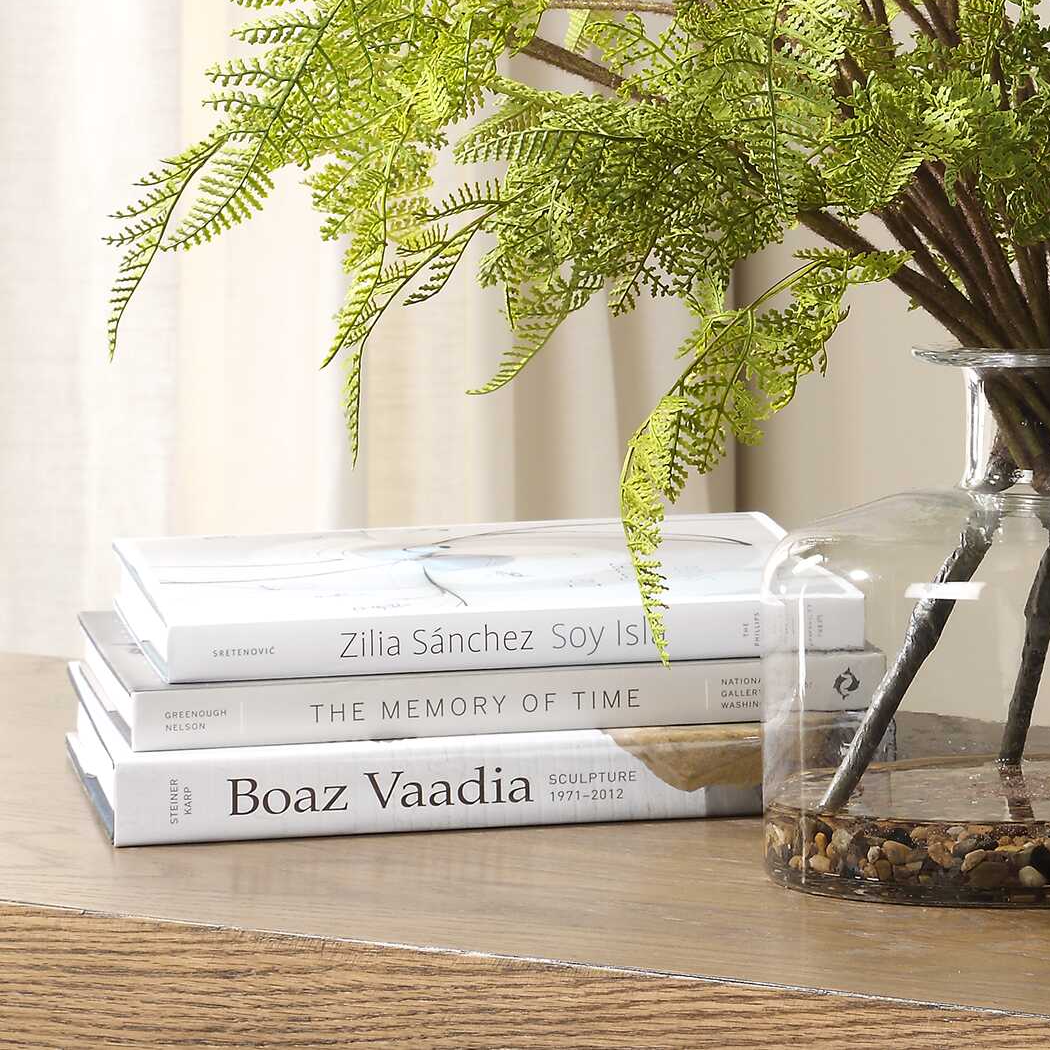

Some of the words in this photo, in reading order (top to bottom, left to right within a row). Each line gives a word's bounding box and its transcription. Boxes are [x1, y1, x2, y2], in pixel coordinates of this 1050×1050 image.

[339, 629, 401, 659] Zilia
[412, 624, 535, 656] Sánchez
[551, 622, 605, 656] Soy
[164, 709, 228, 720] GREENOUGH
[310, 702, 366, 723] THE
[381, 695, 506, 720] MEMORY
[522, 693, 557, 713] OF
[572, 688, 641, 710] TIME
[720, 700, 761, 710] WASHIN
[165, 722, 206, 733] NELSON
[227, 778, 349, 817] Boaz
[363, 765, 535, 809] Vaadia
[549, 770, 637, 786] SCULPTURE
[169, 778, 179, 825] STEINER
[184, 786, 193, 816] KARP
